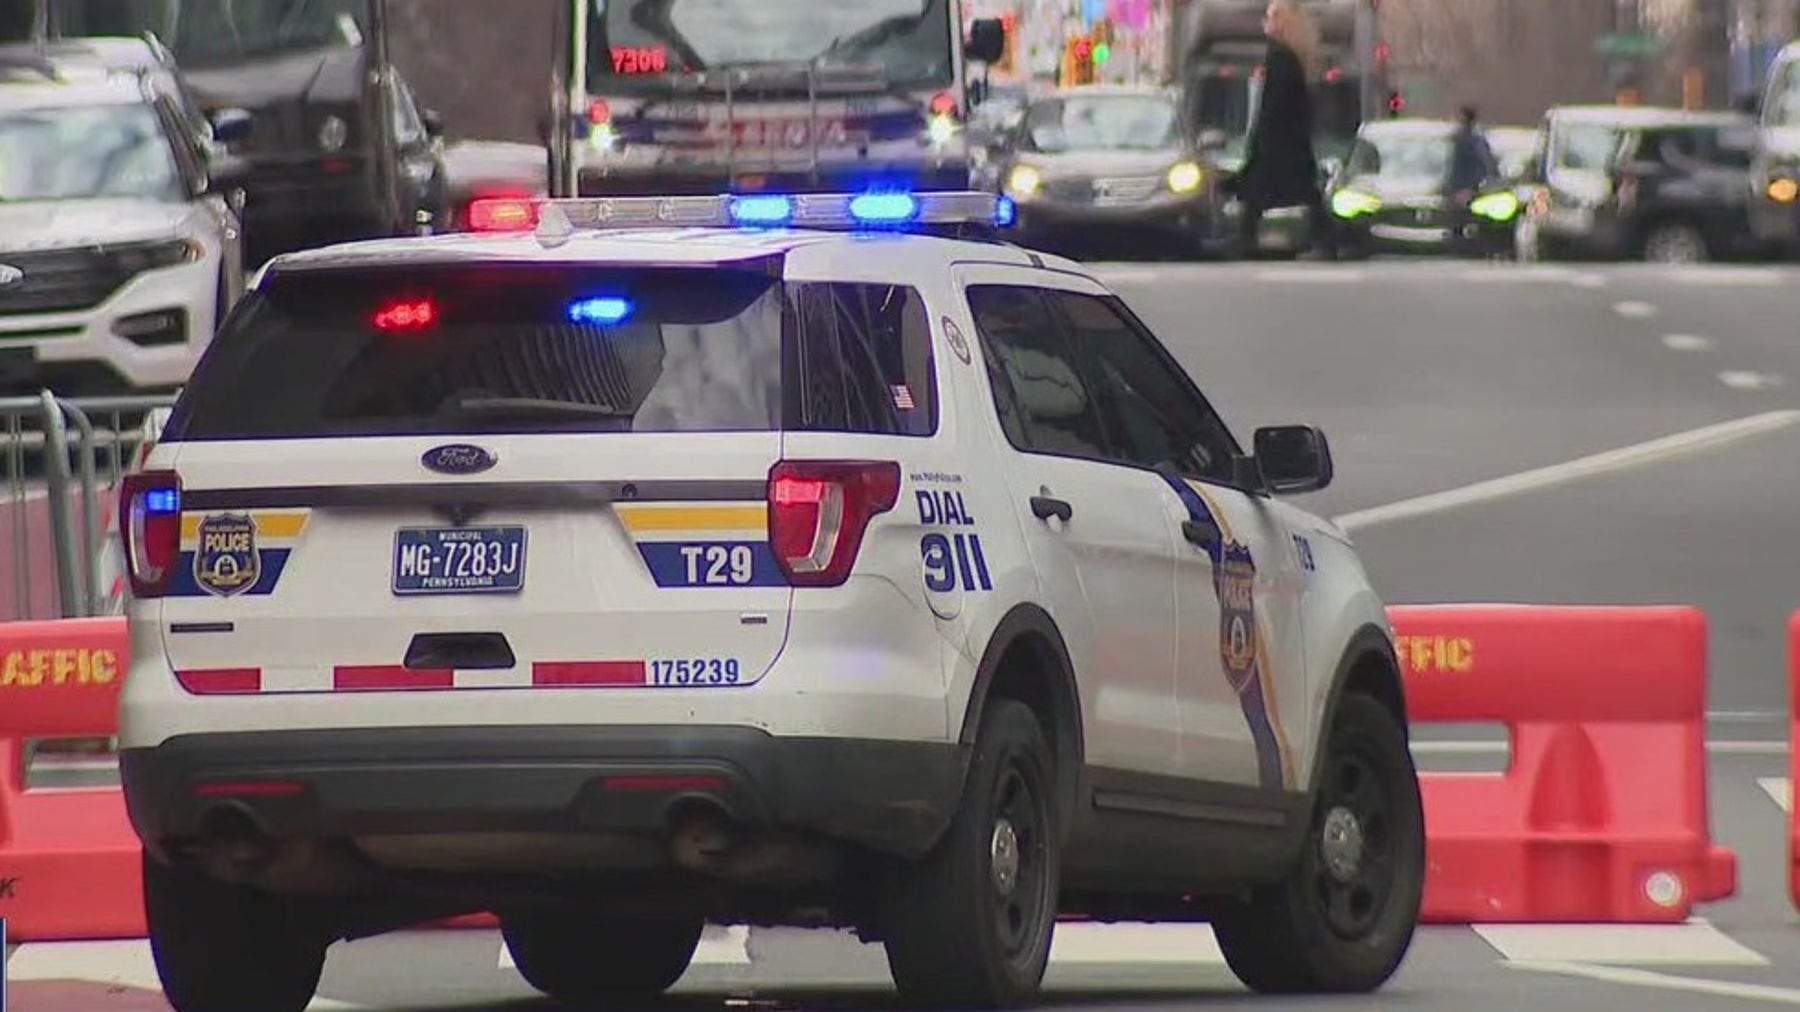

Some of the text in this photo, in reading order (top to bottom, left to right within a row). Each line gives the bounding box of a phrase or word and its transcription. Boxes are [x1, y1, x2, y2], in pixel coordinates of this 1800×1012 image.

[437, 447, 480, 467] Ford
[915, 490, 975, 525] DIAL
[205, 533, 250, 552] POLICE
[439, 531, 482, 541] MUNICIPAL
[401, 541, 518, 577] MG-7283J
[680, 545, 752, 584] T29
[920, 533, 993, 592] 911
[422, 575, 494, 588] PENNSYLVANIA
[651, 658, 739, 684] 175239
